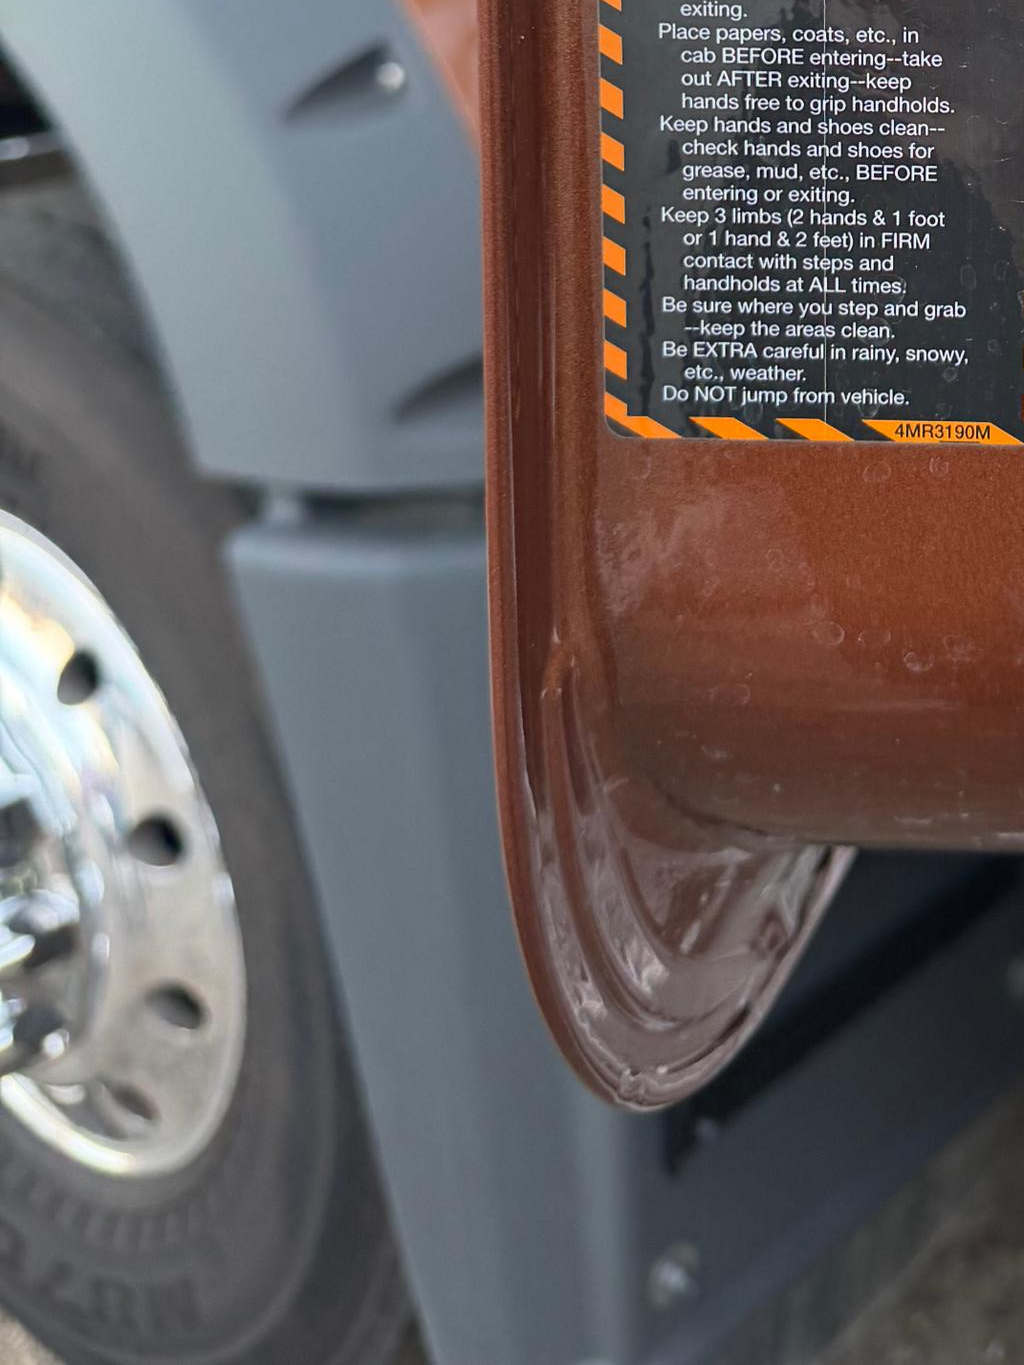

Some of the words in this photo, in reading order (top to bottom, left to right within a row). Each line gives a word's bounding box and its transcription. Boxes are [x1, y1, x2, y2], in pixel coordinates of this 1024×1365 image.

[680, 1, 747, 21] exiting.
[659, 23, 710, 40] Place
[717, 28, 785, 44] papers,
[793, 27, 849, 44] coats,
[856, 28, 895, 45] etc.,
[904, 27, 918, 43] in
[681, 47, 716, 63] cab
[722, 47, 803, 64] BEFORE
[682, 71, 711, 86] out
[717, 71, 781, 87] AFTER
[682, 93, 739, 109] hands
[745, 94, 780, 110] free
[786, 96, 804, 110] to
[810, 95, 846, 116] grip
[853, 96, 954, 113] handholds.
[661, 115, 708, 135] Keep
[714, 116, 771, 133] hands
[777, 118, 811, 134] and
[818, 118, 873, 135] shoes
[682, 139, 738, 155] check
[744, 140, 801, 156] hands
[807, 141, 841, 158] and
[848, 142, 903, 158] shoes
[909, 143, 934, 158] for
[683, 165, 749, 181] grease,
[757, 164, 802, 181] mud,
[810, 165, 849, 182] etc.,
[857, 165, 937, 181] BEFORE
[683, 185, 757, 205] entering
[764, 190, 783, 201] or
[789, 188, 854, 206] exiting.
[662, 207, 709, 226] Keep
[715, 208, 726, 223] 3
[733, 208, 781, 224] limbs
[788, 209, 803, 228] (2
[810, 209, 867, 227] hands
[873, 210, 885, 225] &
[893, 211, 899, 225] 1
[908, 211, 945, 226] foot
[683, 233, 702, 245] or
[709, 230, 716, 245] 1
[726, 230, 771, 246] hand
[777, 231, 790, 247] &
[796, 232, 807, 247] 2
[813, 232, 853, 252] feet)
[860, 232, 874, 248] in
[882, 233, 929, 249] FIRM
[684, 254, 753, 268] contact
[759, 254, 796, 269] with
[803, 256, 853, 274] steps
[860, 256, 893, 271] and
[684, 275, 780, 291] handholds
[786, 277, 803, 292] at
[809, 277, 846, 293] ALL
[851, 277, 906, 294] times.
[663, 297, 687, 312] Be
[693, 301, 732, 313] sure
[738, 298, 793, 314] where
[799, 303, 832, 320] you
[839, 301, 878, 319] step
[884, 301, 918, 316] and
[925, 302, 966, 321] grab
[751, 321, 780, 336] the
[786, 325, 835, 338] areas
[841, 322, 894, 338] clean.
[663, 341, 687, 356] Be
[694, 342, 757, 358] EXTRA
[763, 342, 826, 360] careful
[831, 344, 845, 360] in
[853, 345, 899, 364] rainy,
[906, 349, 968, 366] snowy,
[684, 365, 723, 381] etc.,
[730, 365, 806, 381] weather.
[663, 386, 688, 401] Do
[695, 386, 736, 402] NOT
[741, 387, 787, 406] jump
[793, 387, 834, 405] from
[841, 389, 909, 405] vehicle.
[895, 424, 990, 439] 4MR3190M
